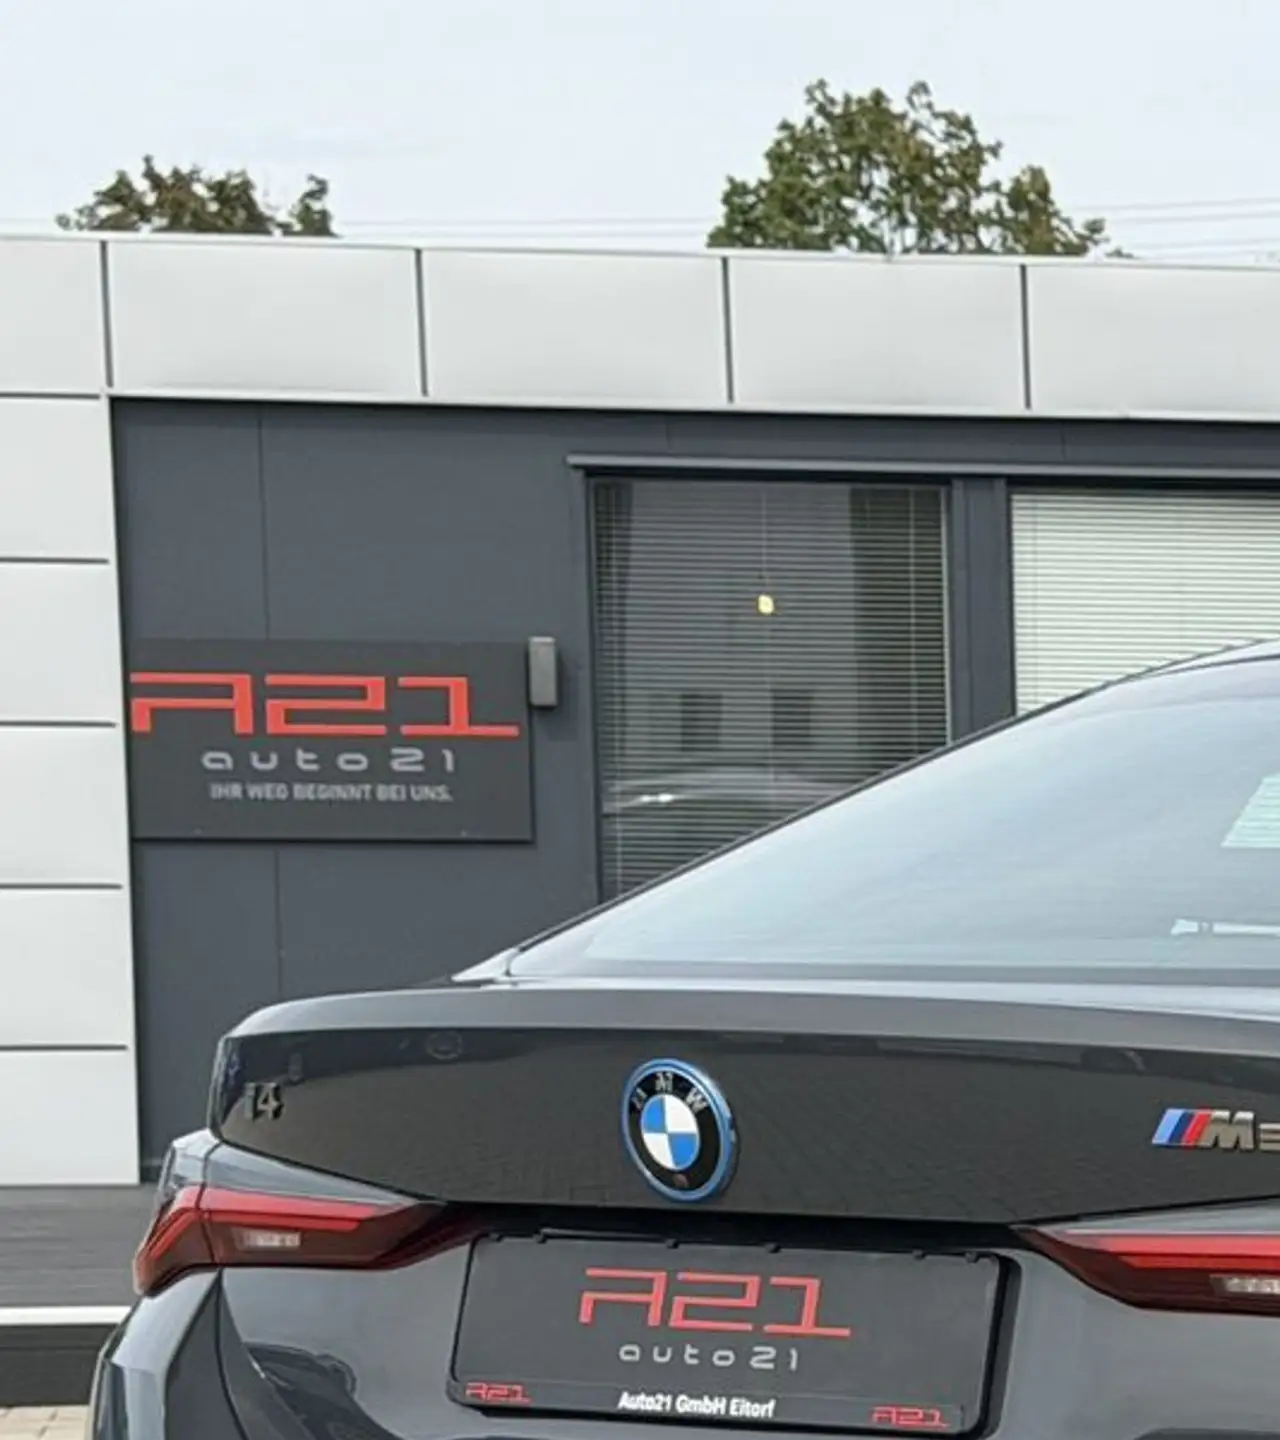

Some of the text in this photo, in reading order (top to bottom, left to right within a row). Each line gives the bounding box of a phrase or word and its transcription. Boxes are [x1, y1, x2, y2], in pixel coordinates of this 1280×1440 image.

[130, 672, 520, 737] A21
[210, 781, 453, 802] IHR WEG BEGINNT BEI UNS.
[631, 1072, 709, 1113] BMW
[578, 1267, 851, 1337] A21
[617, 1391, 776, 1418] Auto21 GmbH Eitorf
